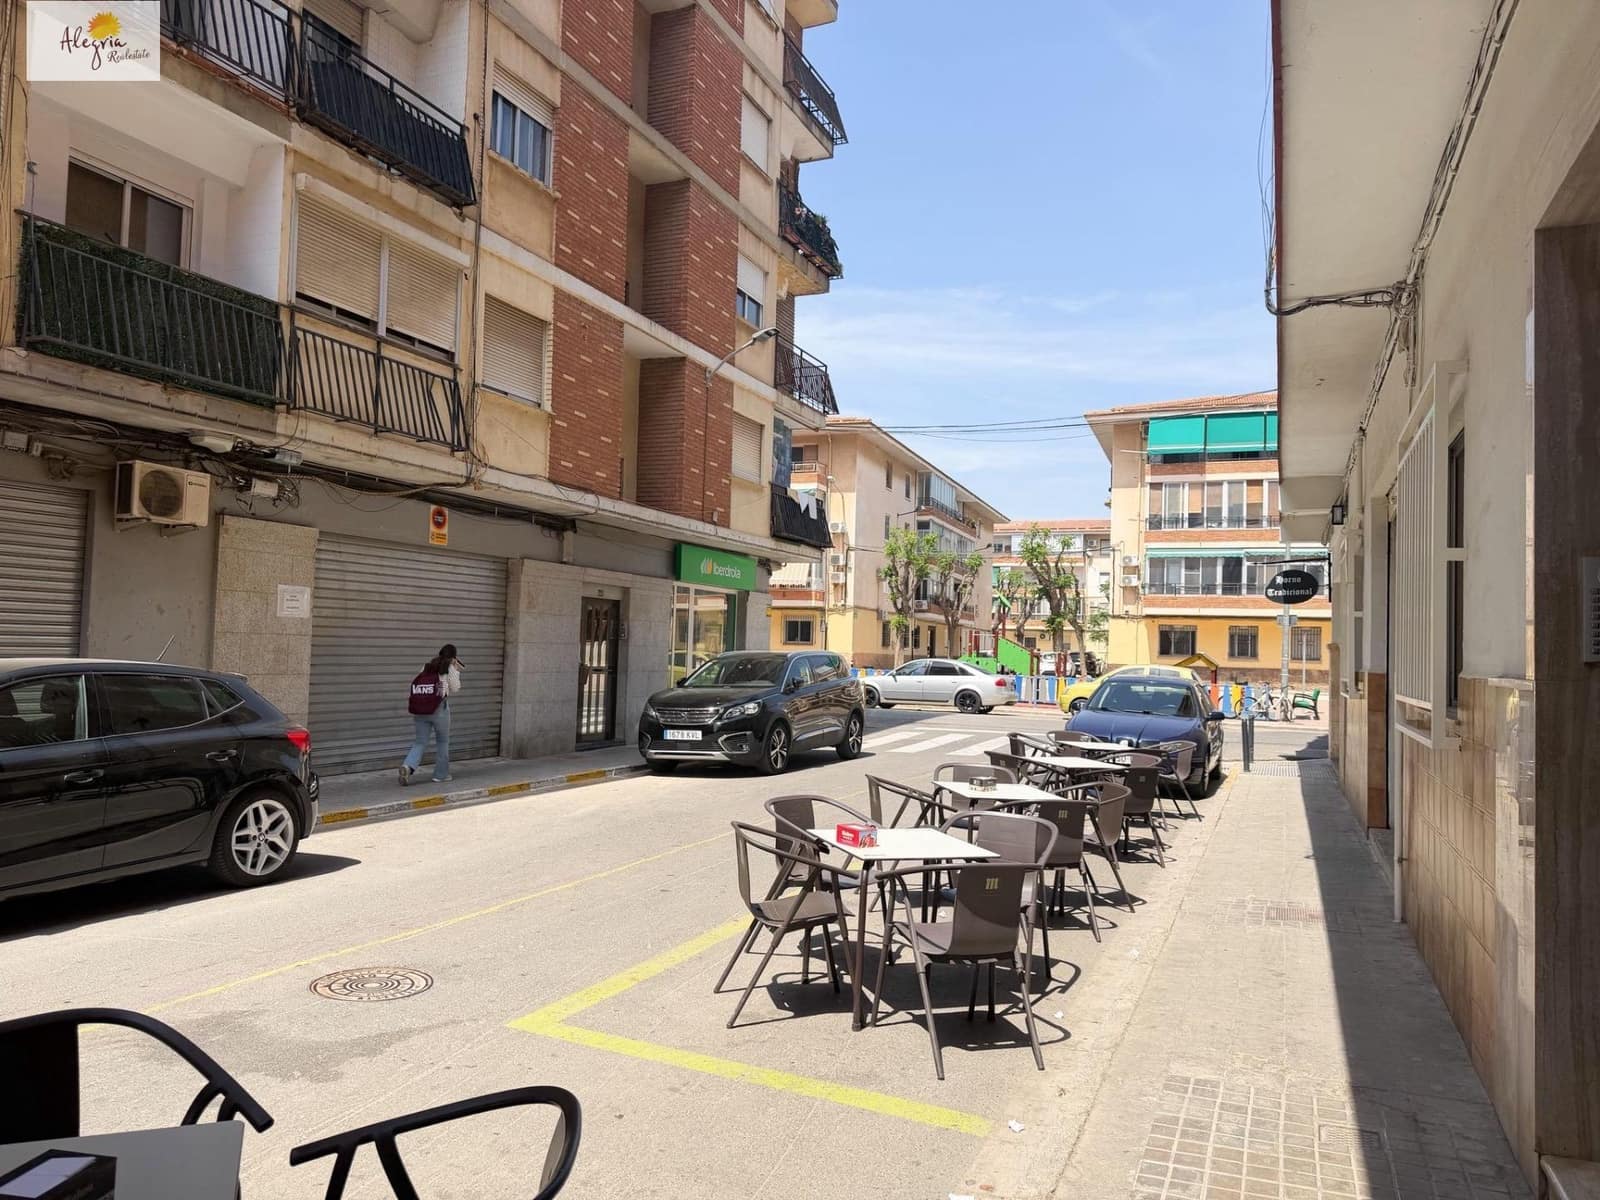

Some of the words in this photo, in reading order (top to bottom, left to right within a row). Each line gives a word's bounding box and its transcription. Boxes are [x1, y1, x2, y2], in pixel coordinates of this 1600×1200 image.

[1276, 576, 1301, 585] Horno
[1267, 588, 1313, 596] Tradicional
[412, 684, 435, 694] VANS
